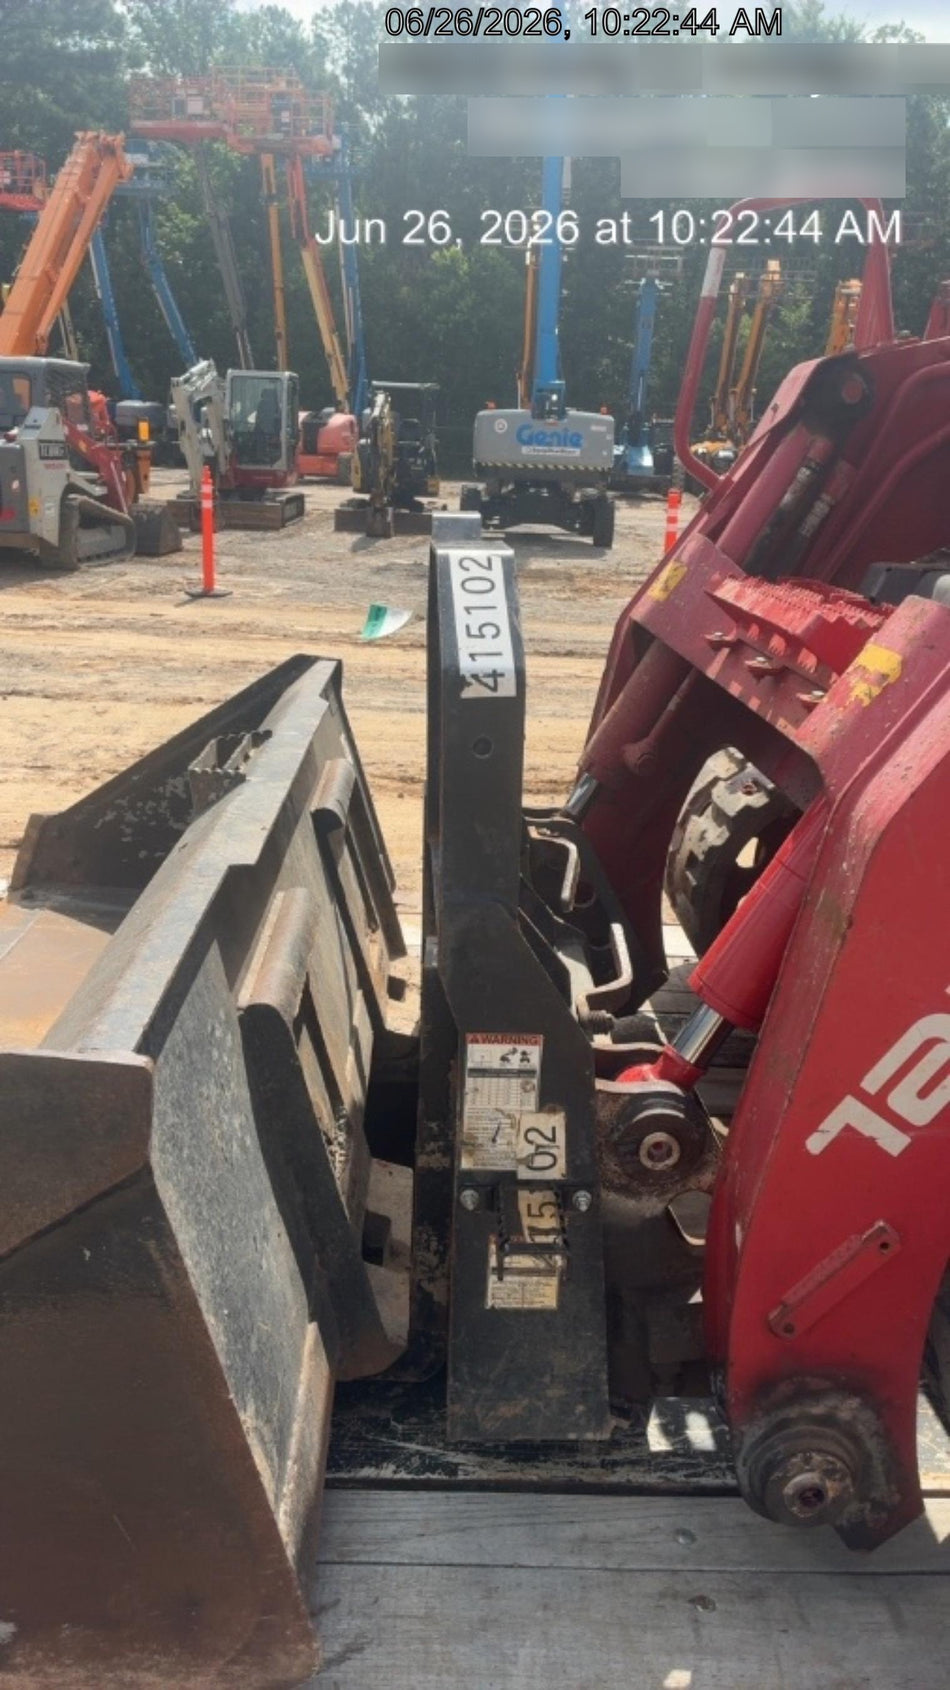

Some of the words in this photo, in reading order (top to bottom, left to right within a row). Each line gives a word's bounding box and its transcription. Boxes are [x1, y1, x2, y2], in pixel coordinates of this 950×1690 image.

[516, 424, 583, 448] Genie
[458, 556, 505, 692] 415102
[481, 1034, 538, 1046] WARNING
